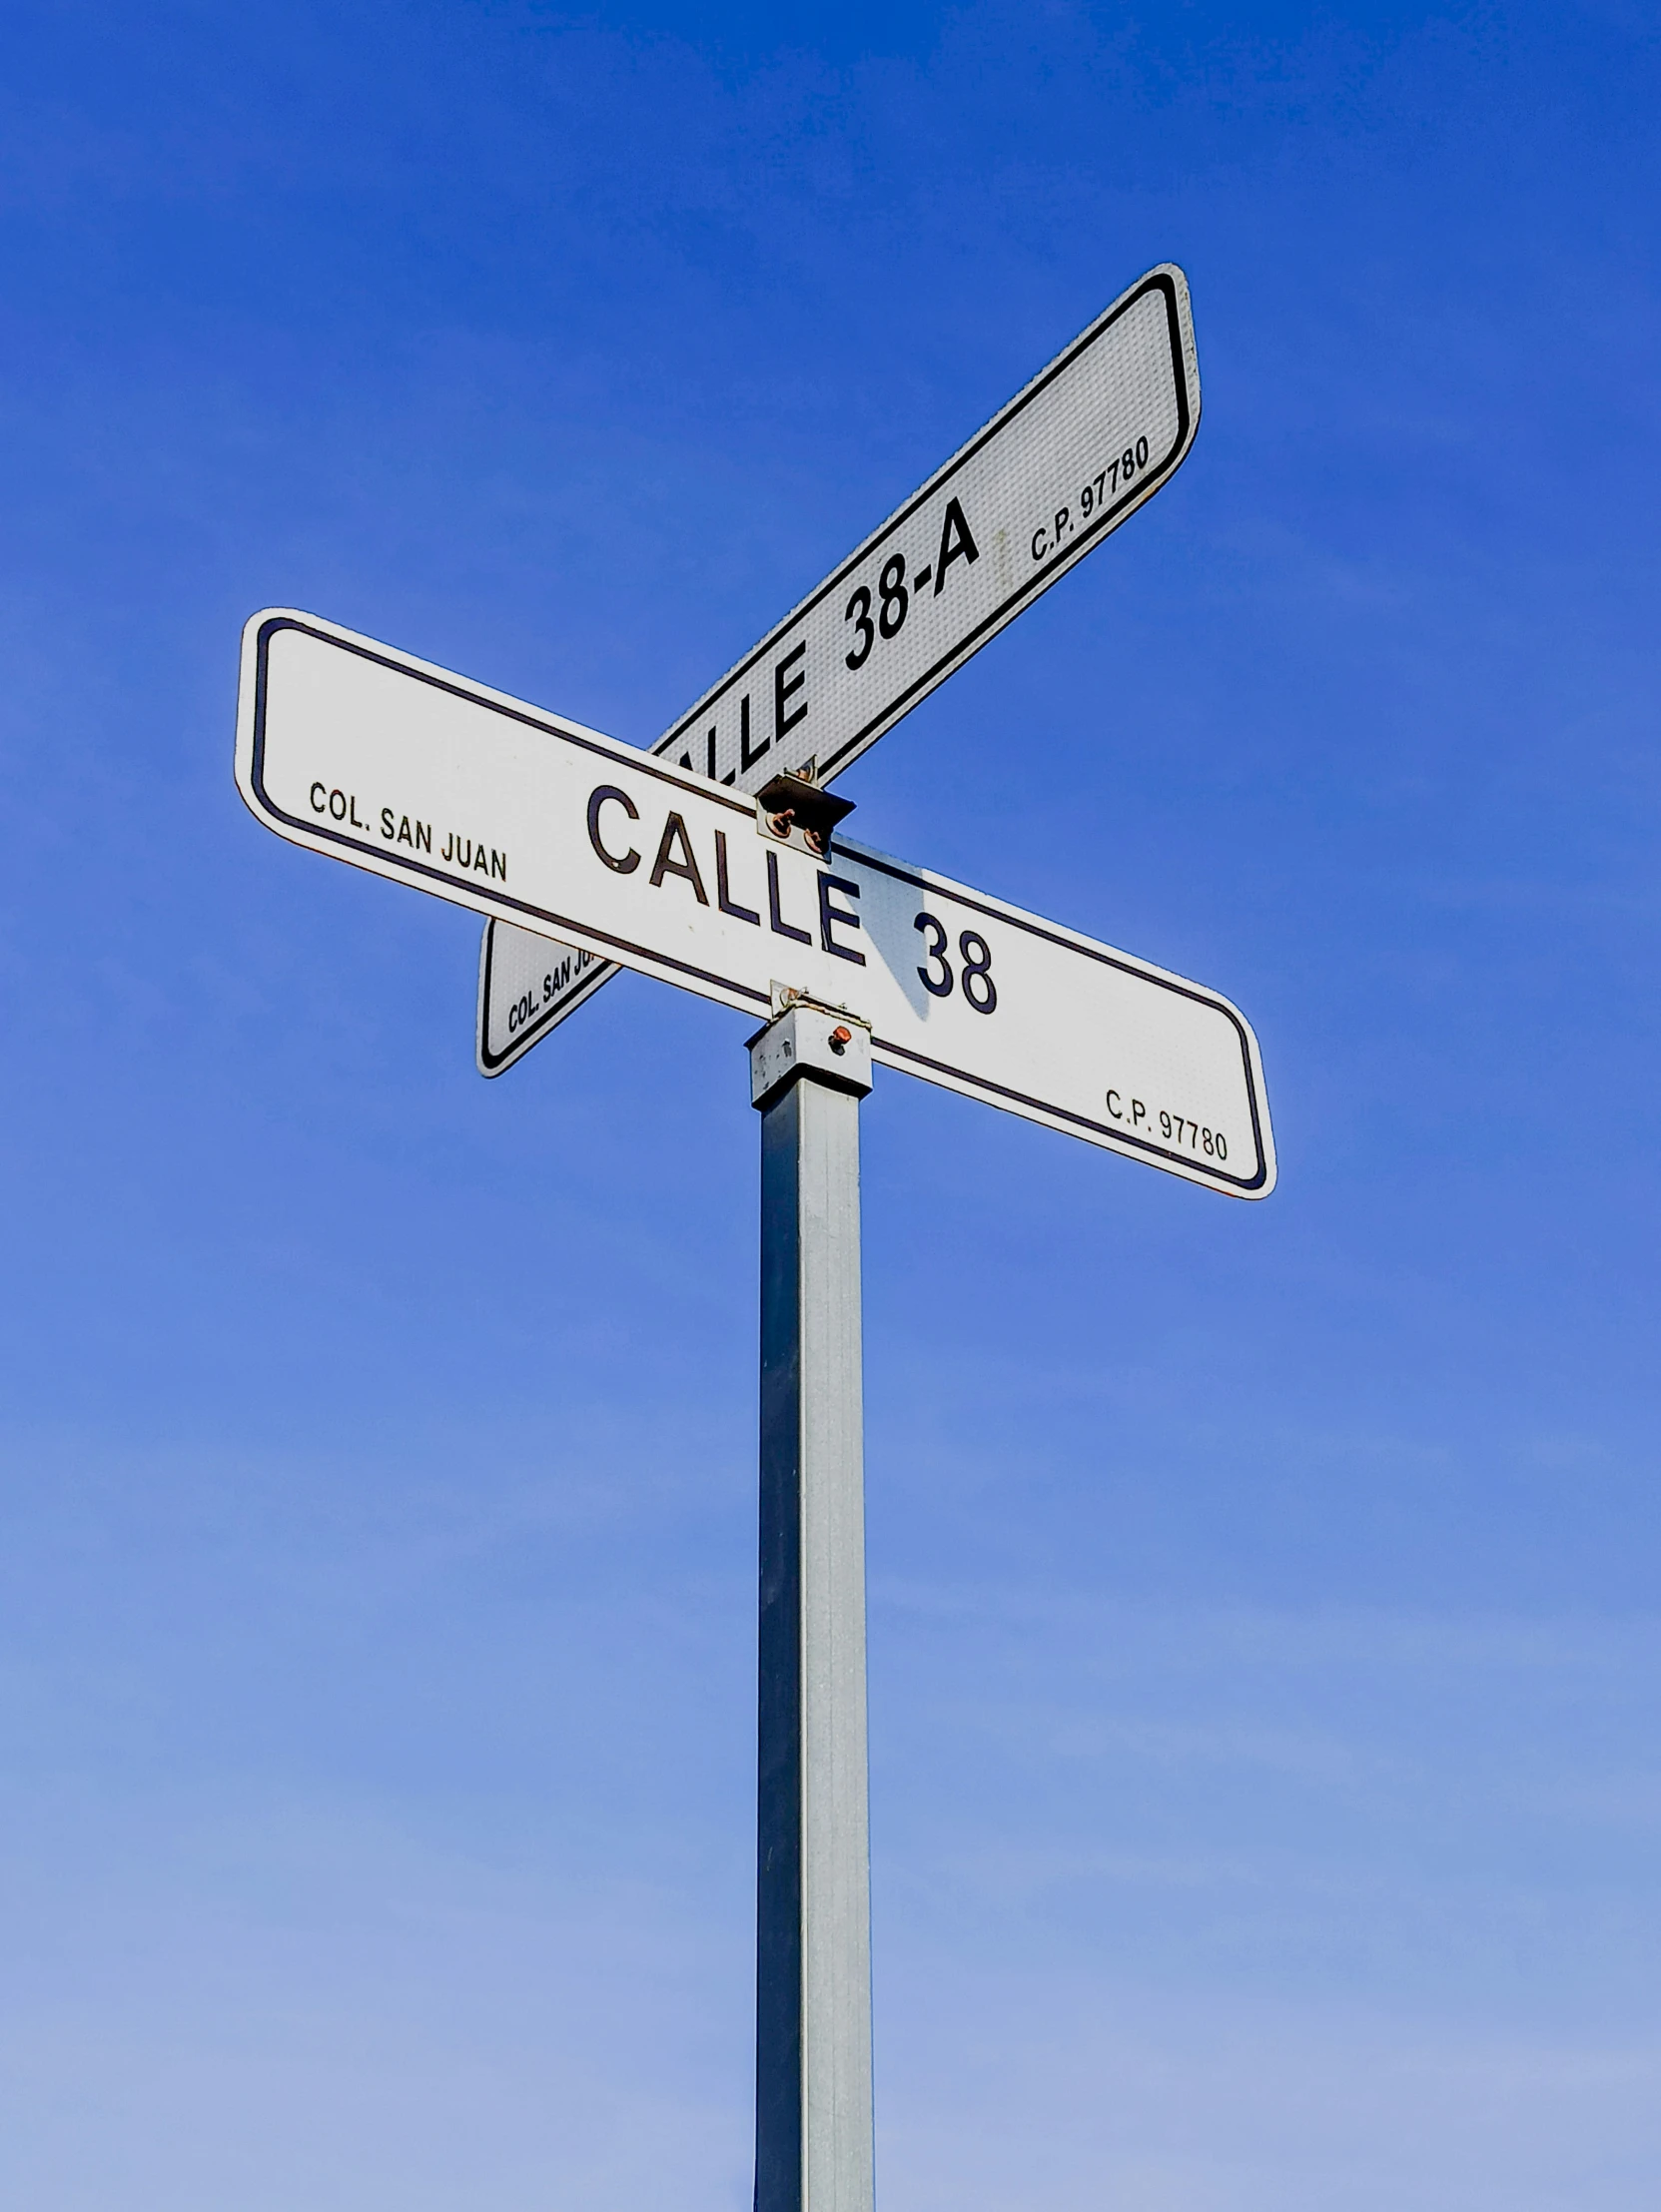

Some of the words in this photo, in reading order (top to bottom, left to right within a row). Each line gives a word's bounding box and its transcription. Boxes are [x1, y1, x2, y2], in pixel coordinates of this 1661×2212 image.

[1031, 506, 1075, 561] C.P.
[1080, 435, 1150, 519] 97780
[678, 639, 809, 787] LLE
[844, 495, 980, 672] 38-A
[310, 781, 371, 831] COL.
[381, 807, 432, 855] SAN
[441, 835, 507, 882] JUAN
[586, 784, 867, 968] CALLE
[913, 911, 998, 1016] 38
[508, 990, 540, 1034] COL.
[542, 956, 571, 1004] SAN
[1106, 1089, 1152, 1132] C.P.
[1159, 1109, 1228, 1161] 97780
